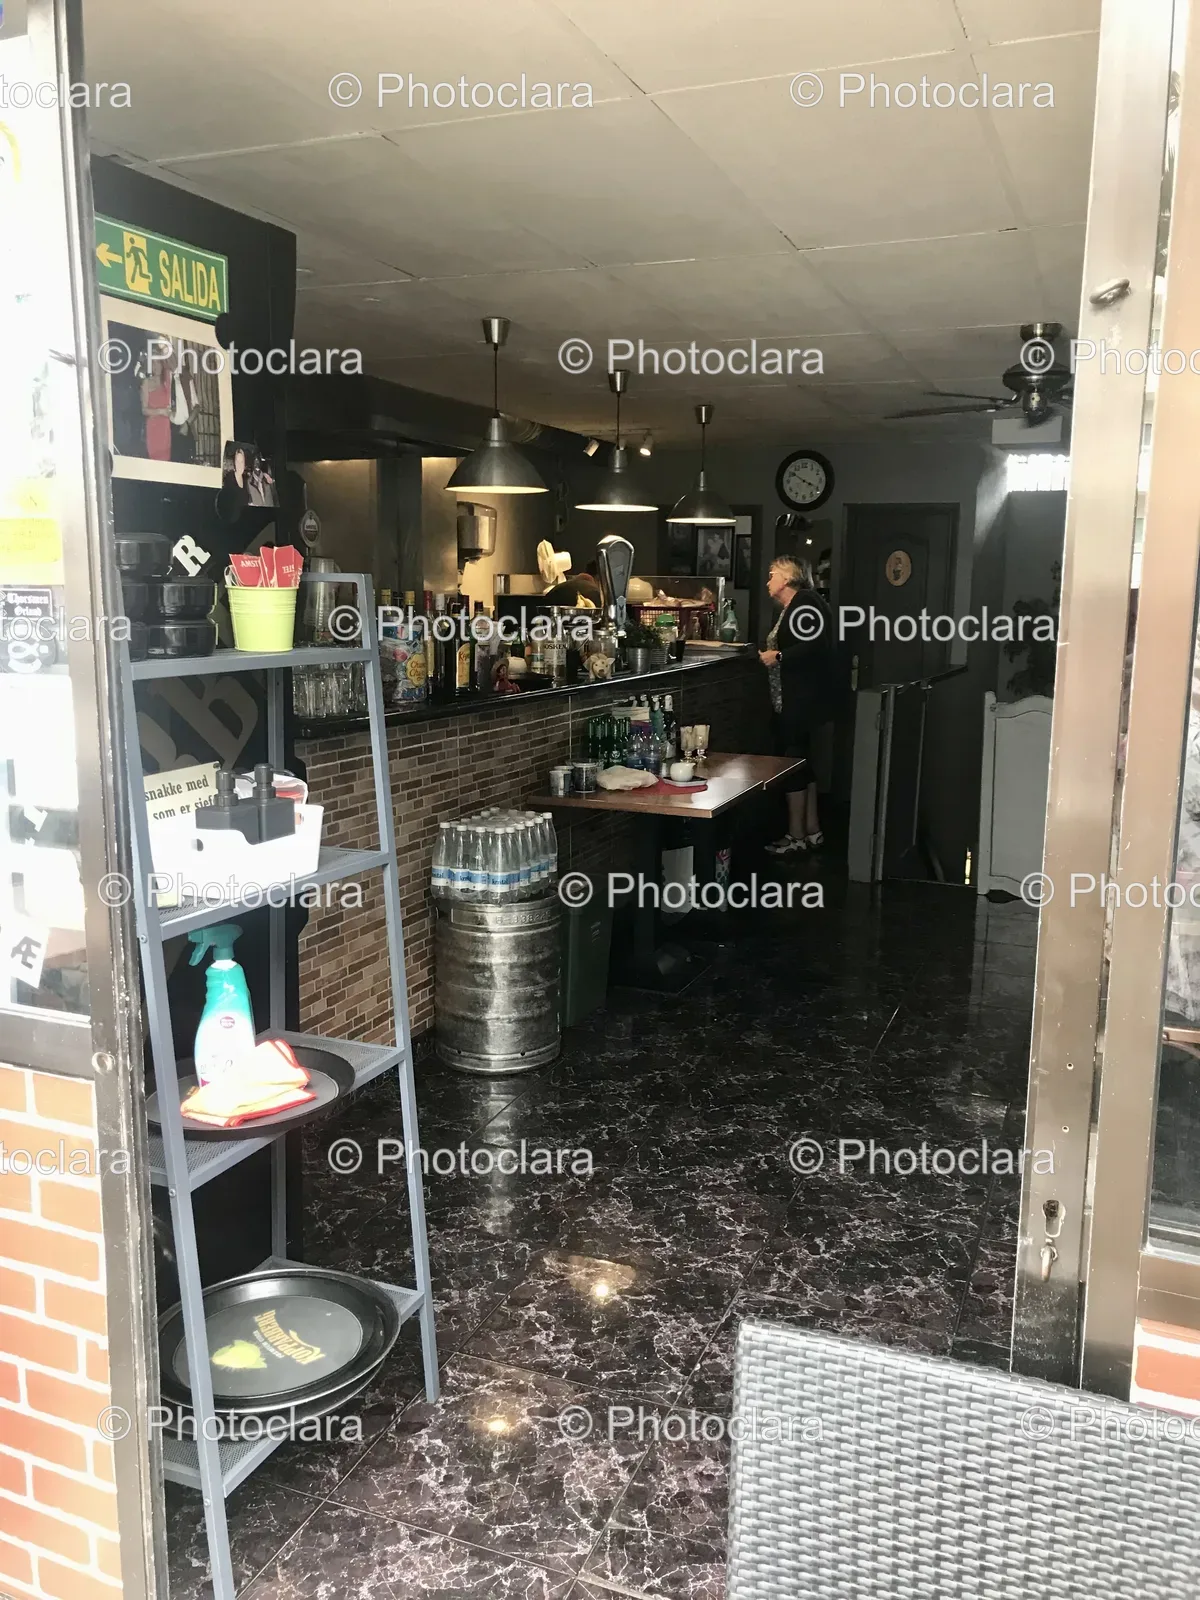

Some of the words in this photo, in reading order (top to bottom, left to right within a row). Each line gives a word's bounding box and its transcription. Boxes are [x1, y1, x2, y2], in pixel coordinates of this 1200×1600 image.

[159, 250, 221, 311] SALIDA
[172, 535, 211, 577] R
[144, 782, 183, 802] snakke
[185, 774, 210, 791] med
[153, 808, 176, 820] som
[180, 804, 191, 814] er
[10, 936, 42, 970] Æ
